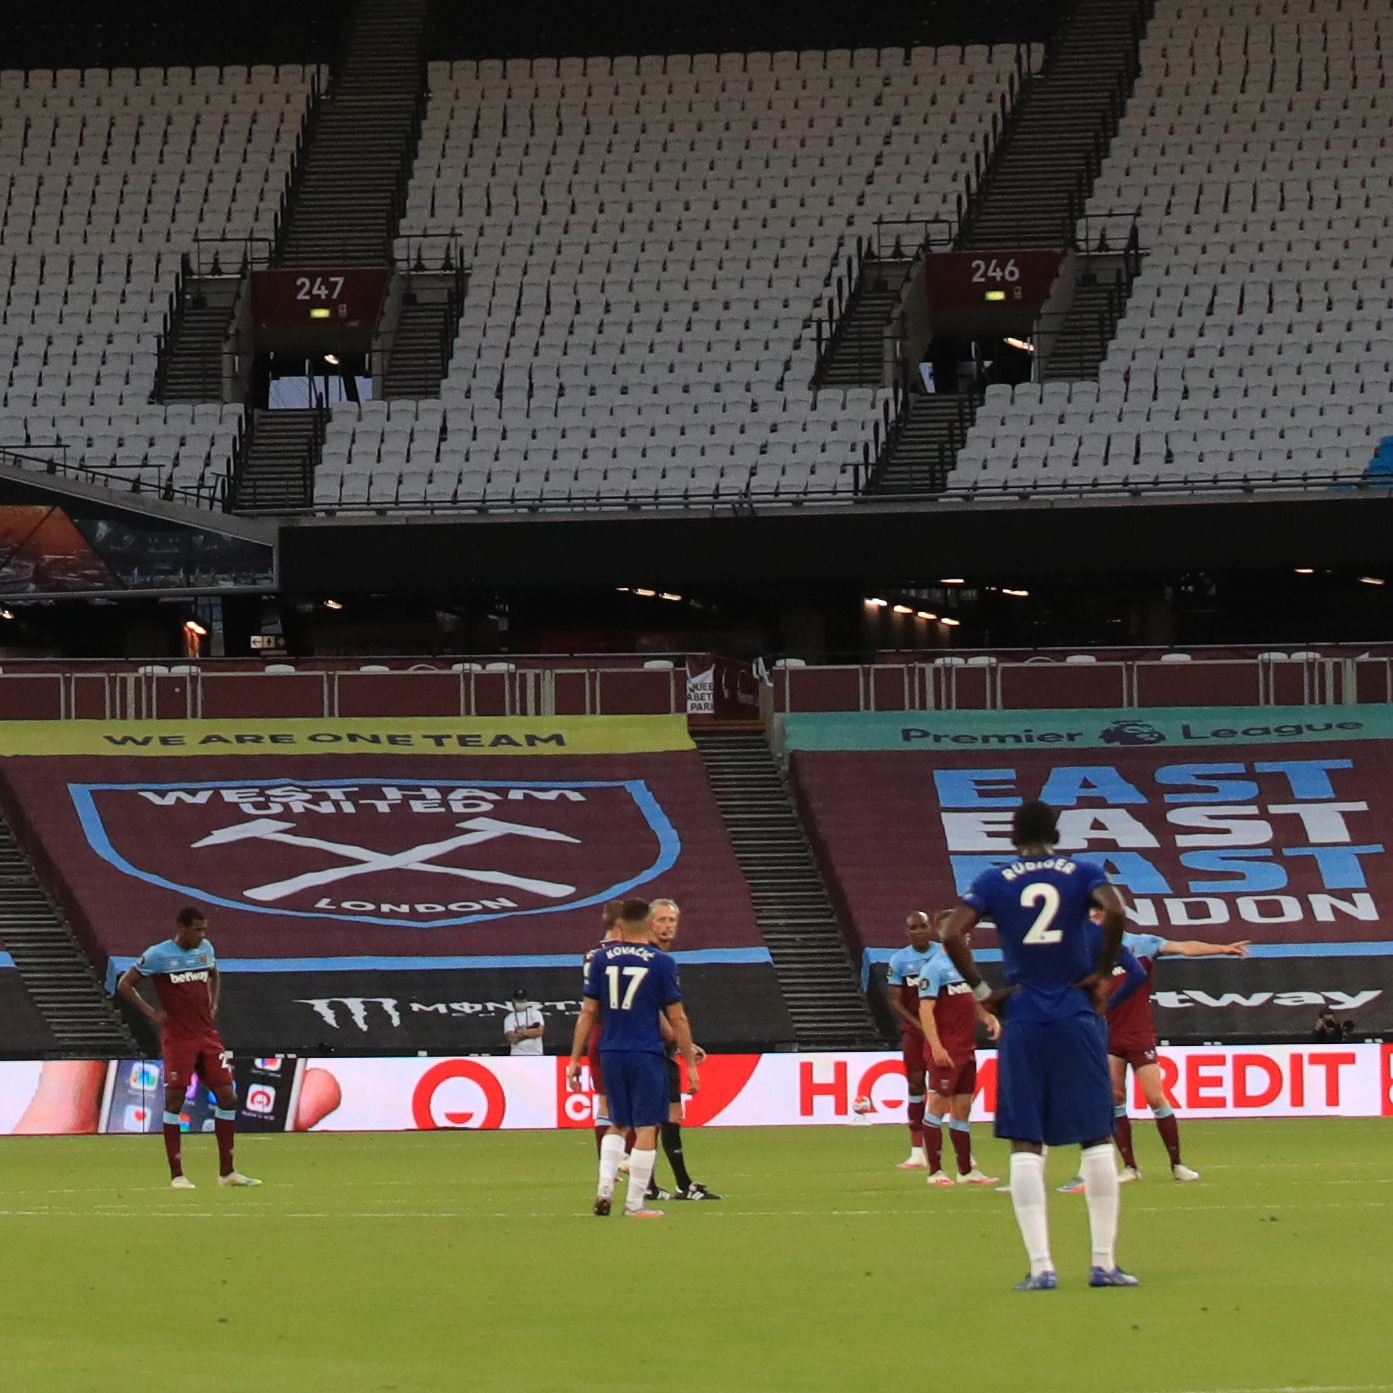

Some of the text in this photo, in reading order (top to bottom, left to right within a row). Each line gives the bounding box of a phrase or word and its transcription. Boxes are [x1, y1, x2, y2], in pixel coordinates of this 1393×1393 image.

[971, 258, 1020, 283] 246
[296, 276, 345, 301] 247
[102, 732, 567, 748] WE ARE ONE TEAM
[901, 717, 1365, 745] Premier League
[933, 758, 1354, 808] EAST
[137, 785, 588, 807] WEST HAM
[238, 798, 496, 816] UNITED
[940, 800, 1370, 852] EAST
[315, 896, 519, 914] LONDON
[1020, 882, 1064, 945] 2
[1123, 892, 1380, 927] NDON
[169, 970, 209, 984] betway
[605, 965, 649, 1010] 17
[1148, 989, 1384, 1010] tway
[1132, 1051, 1356, 1108] REDIT
